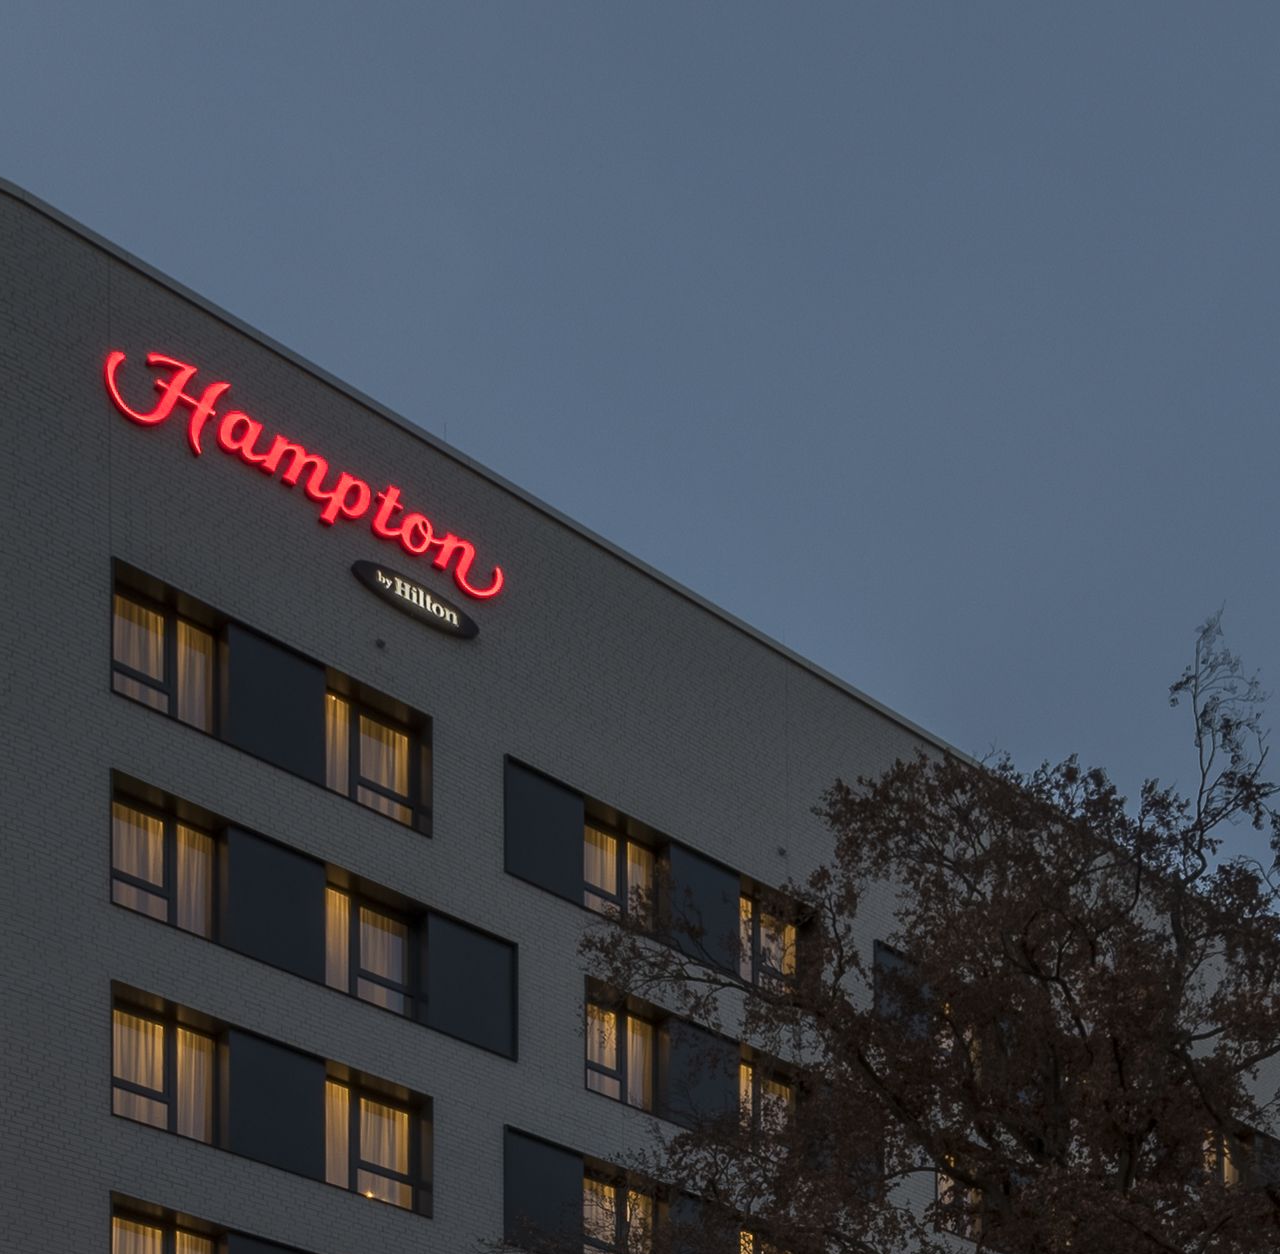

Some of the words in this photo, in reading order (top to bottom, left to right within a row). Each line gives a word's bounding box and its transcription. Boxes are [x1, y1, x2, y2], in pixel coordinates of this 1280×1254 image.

[103, 350, 505, 599] Hampton
[376, 569, 392, 589] by
[394, 576, 459, 628] Hilton
